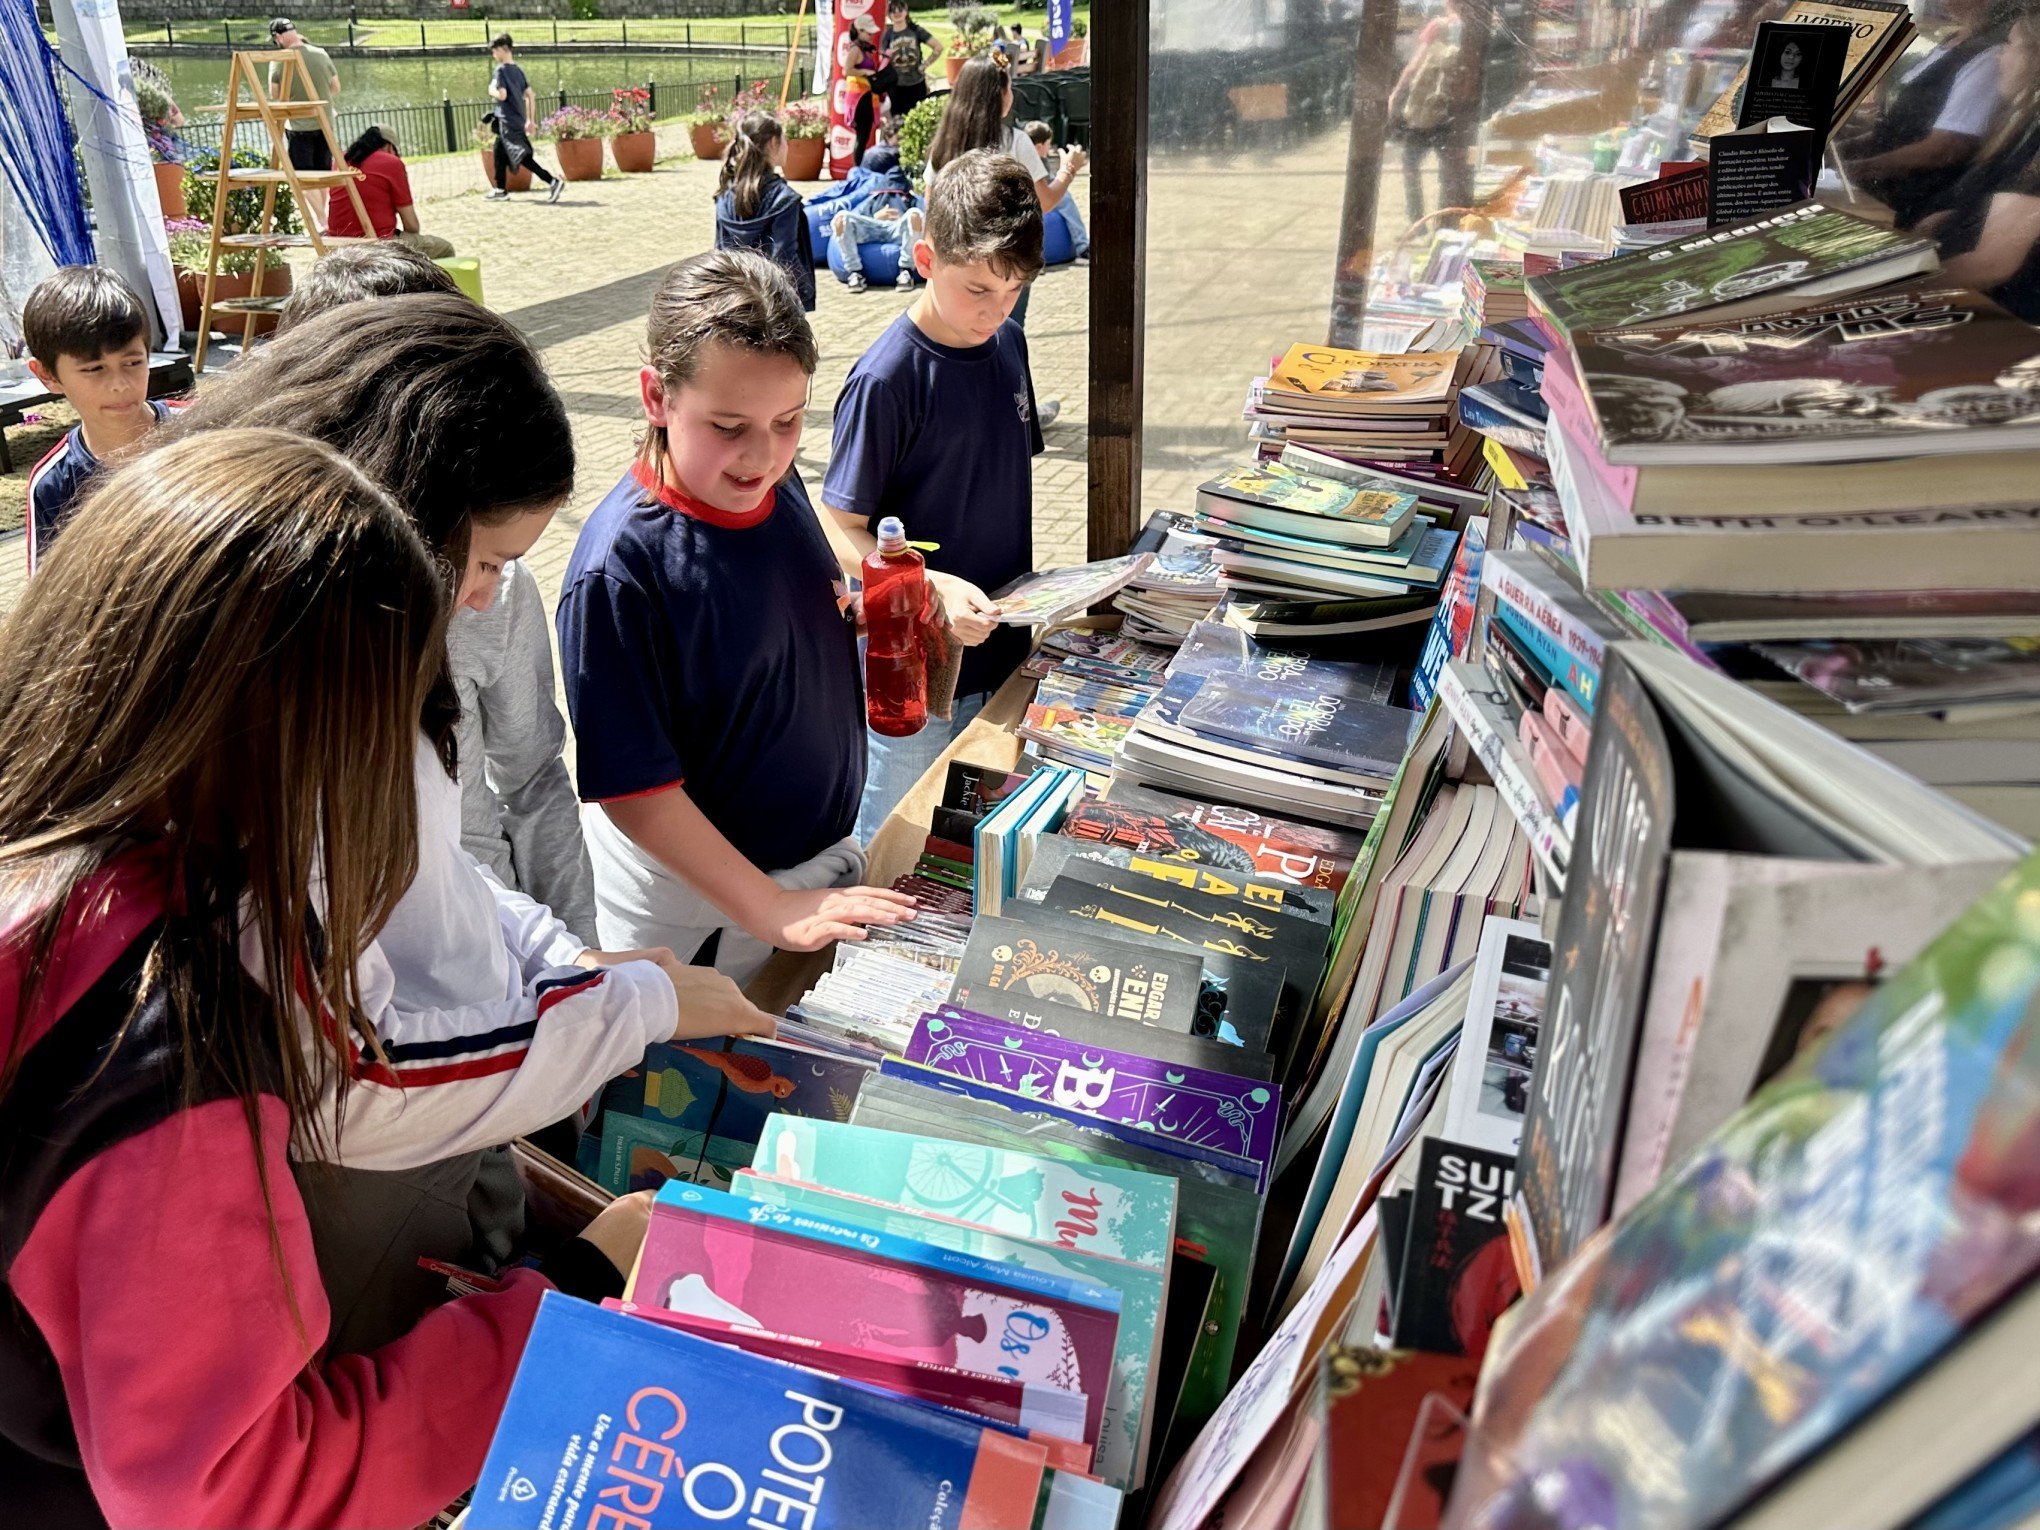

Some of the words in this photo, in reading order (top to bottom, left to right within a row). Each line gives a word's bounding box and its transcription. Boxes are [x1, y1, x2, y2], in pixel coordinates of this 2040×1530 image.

[1717, 183, 1746, 191] publicações
[1302, 351, 1444, 369] CLEOPATRA
[1635, 513, 1778, 530] BETH
[1799, 506, 2040, 530] O'LEARY
[1502, 578, 1536, 618] GUERRA
[1534, 601, 1564, 637] AÉREA
[1277, 700, 1313, 737] TEMPO
[1304, 695, 1341, 734] DOBRA
[960, 771, 981, 807] Jackie
[1147, 971, 1170, 1021] EDGAR
[1433, 1179, 1510, 1224] TZ
[942, 1254, 981, 1270] Alcott
[982, 1261, 1012, 1278] May
[1012, 1270, 1058, 1289] Louisa
[916, 1359, 958, 1375] WATTLES
[968, 1370, 1012, 1384] WALLACE
[592, 1412, 613, 1441] Use
[1095, 1405, 1118, 1466] Louisa
[561, 1433, 582, 1469] vida
[588, 1441, 599, 1453] a
[746, 1389, 845, 1530] POTE
[572, 1453, 598, 1500] mente
[682, 1462, 747, 1520] O
